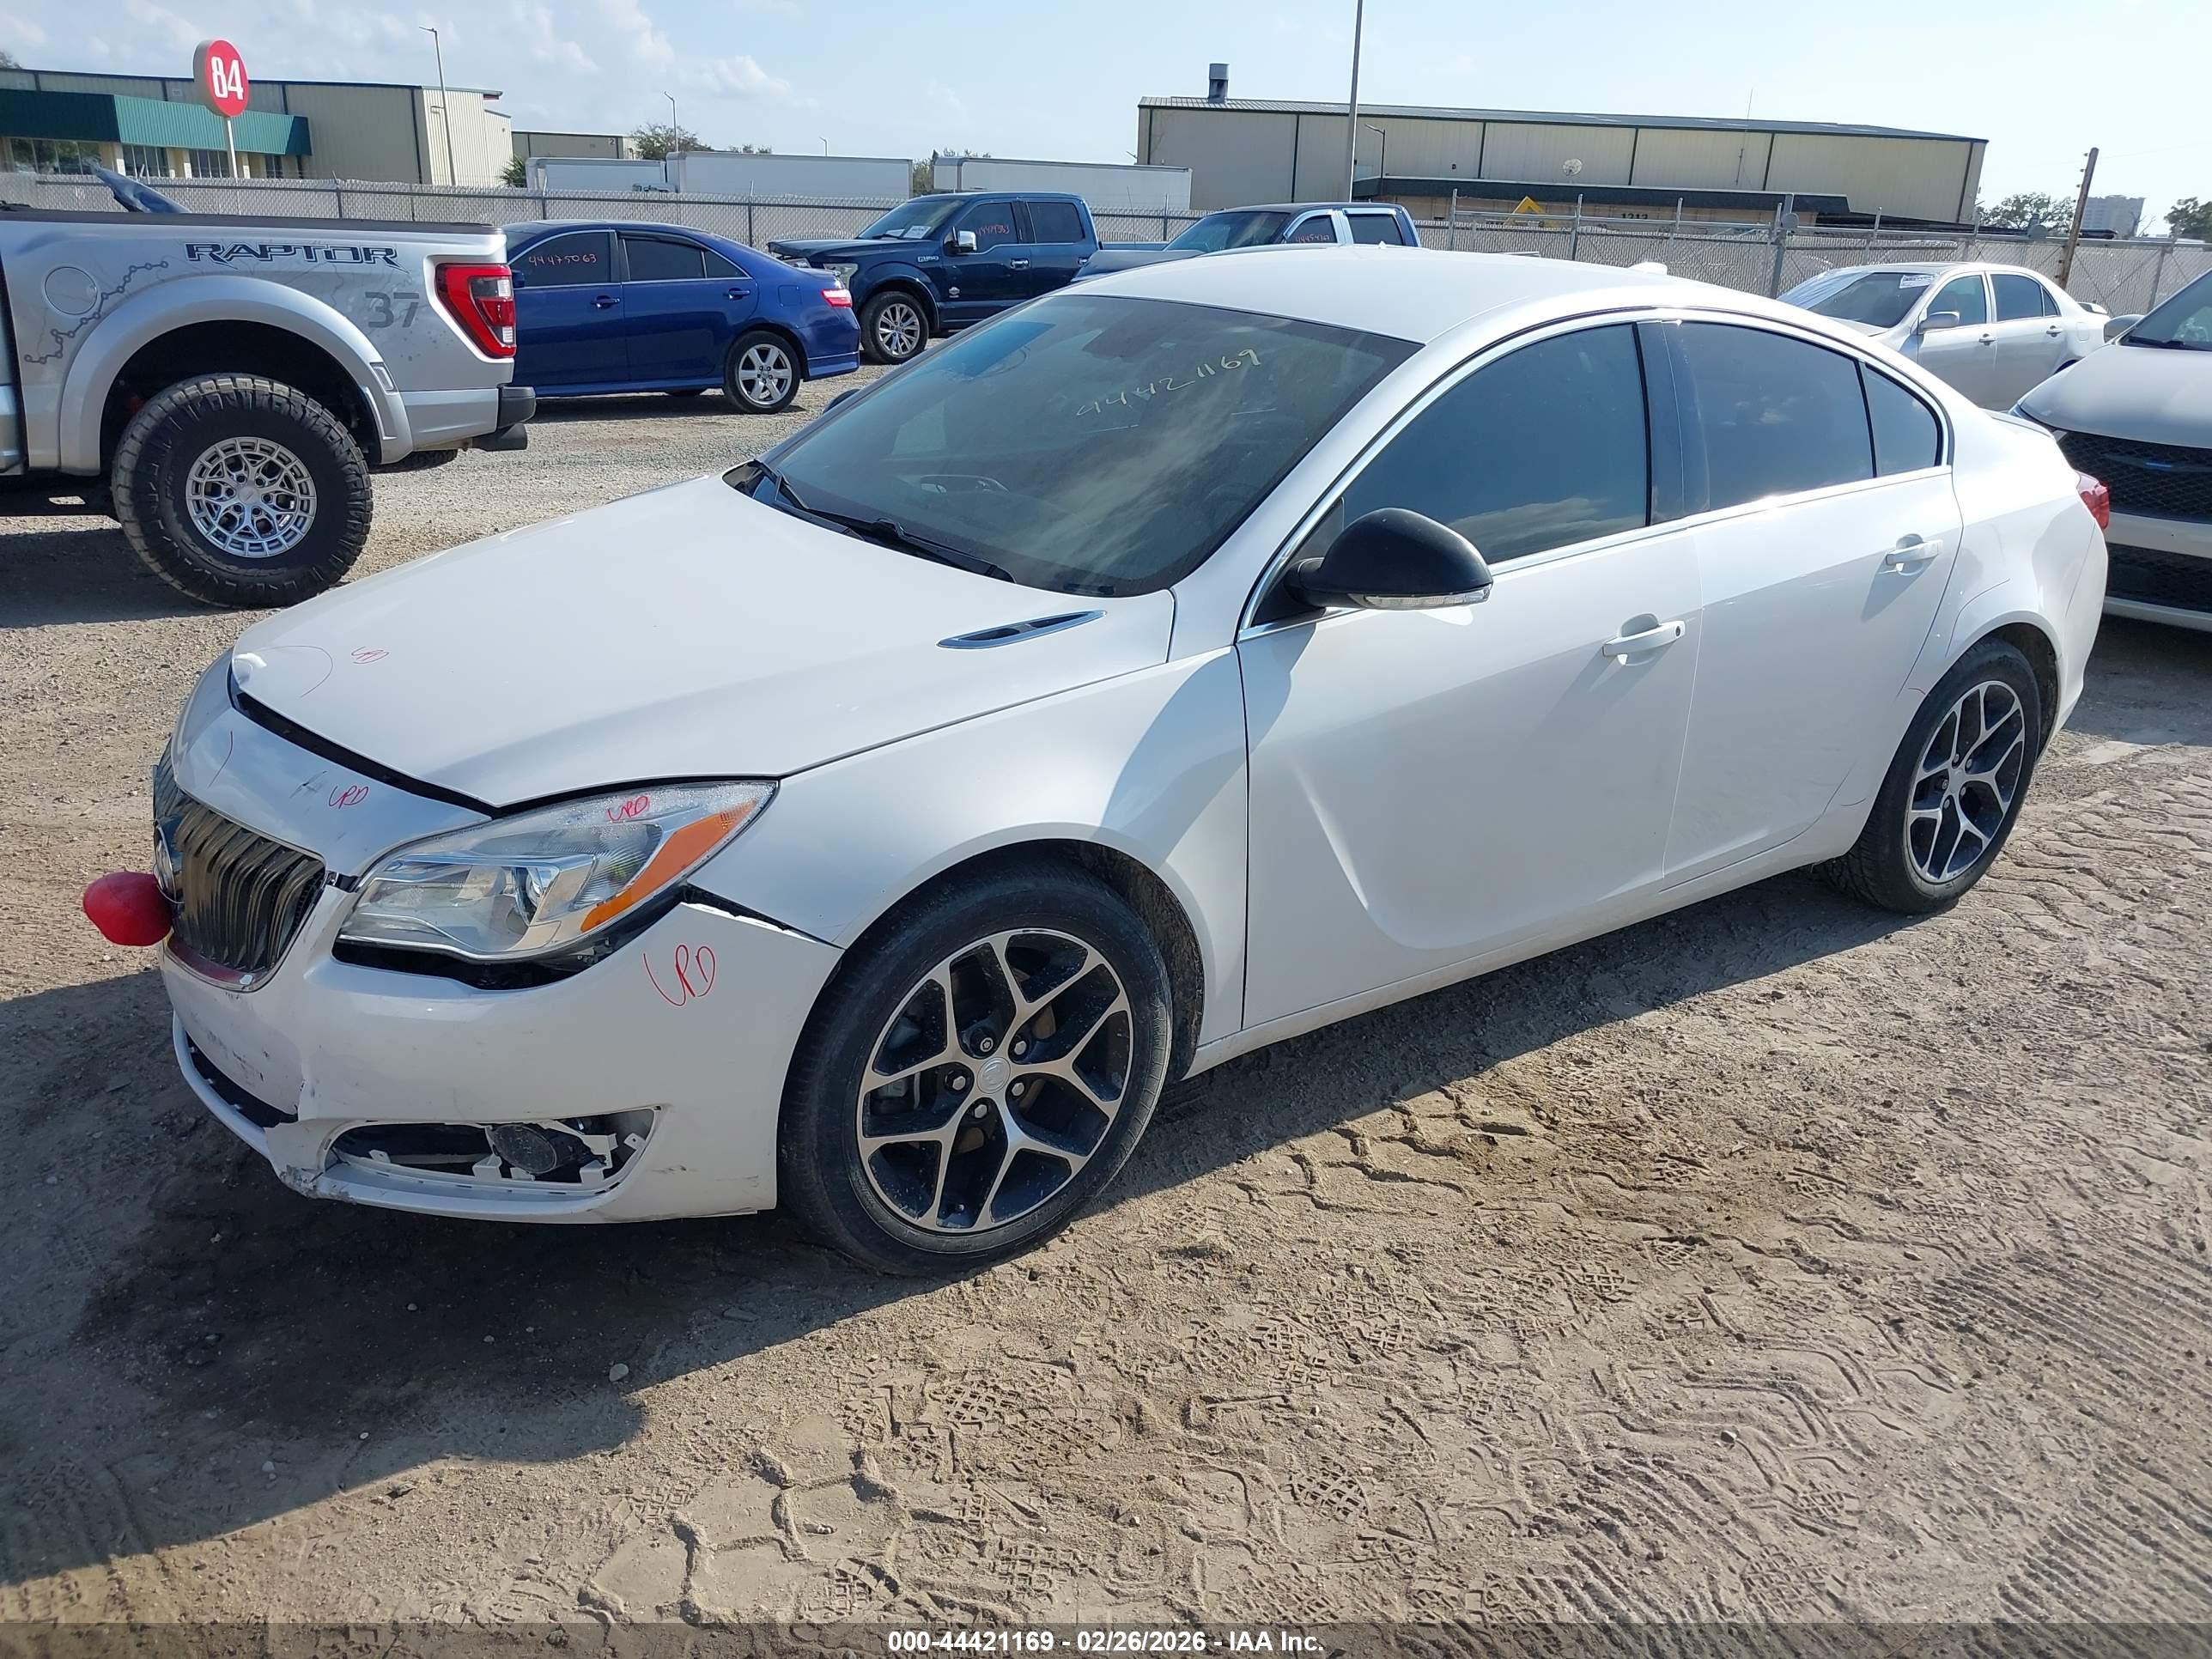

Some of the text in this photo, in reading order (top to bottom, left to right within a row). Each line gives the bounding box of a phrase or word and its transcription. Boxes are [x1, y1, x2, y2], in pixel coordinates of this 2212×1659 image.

[211, 56, 244, 100] 84
[185, 242, 410, 274] RAPTOR
[365, 291, 420, 328] 37
